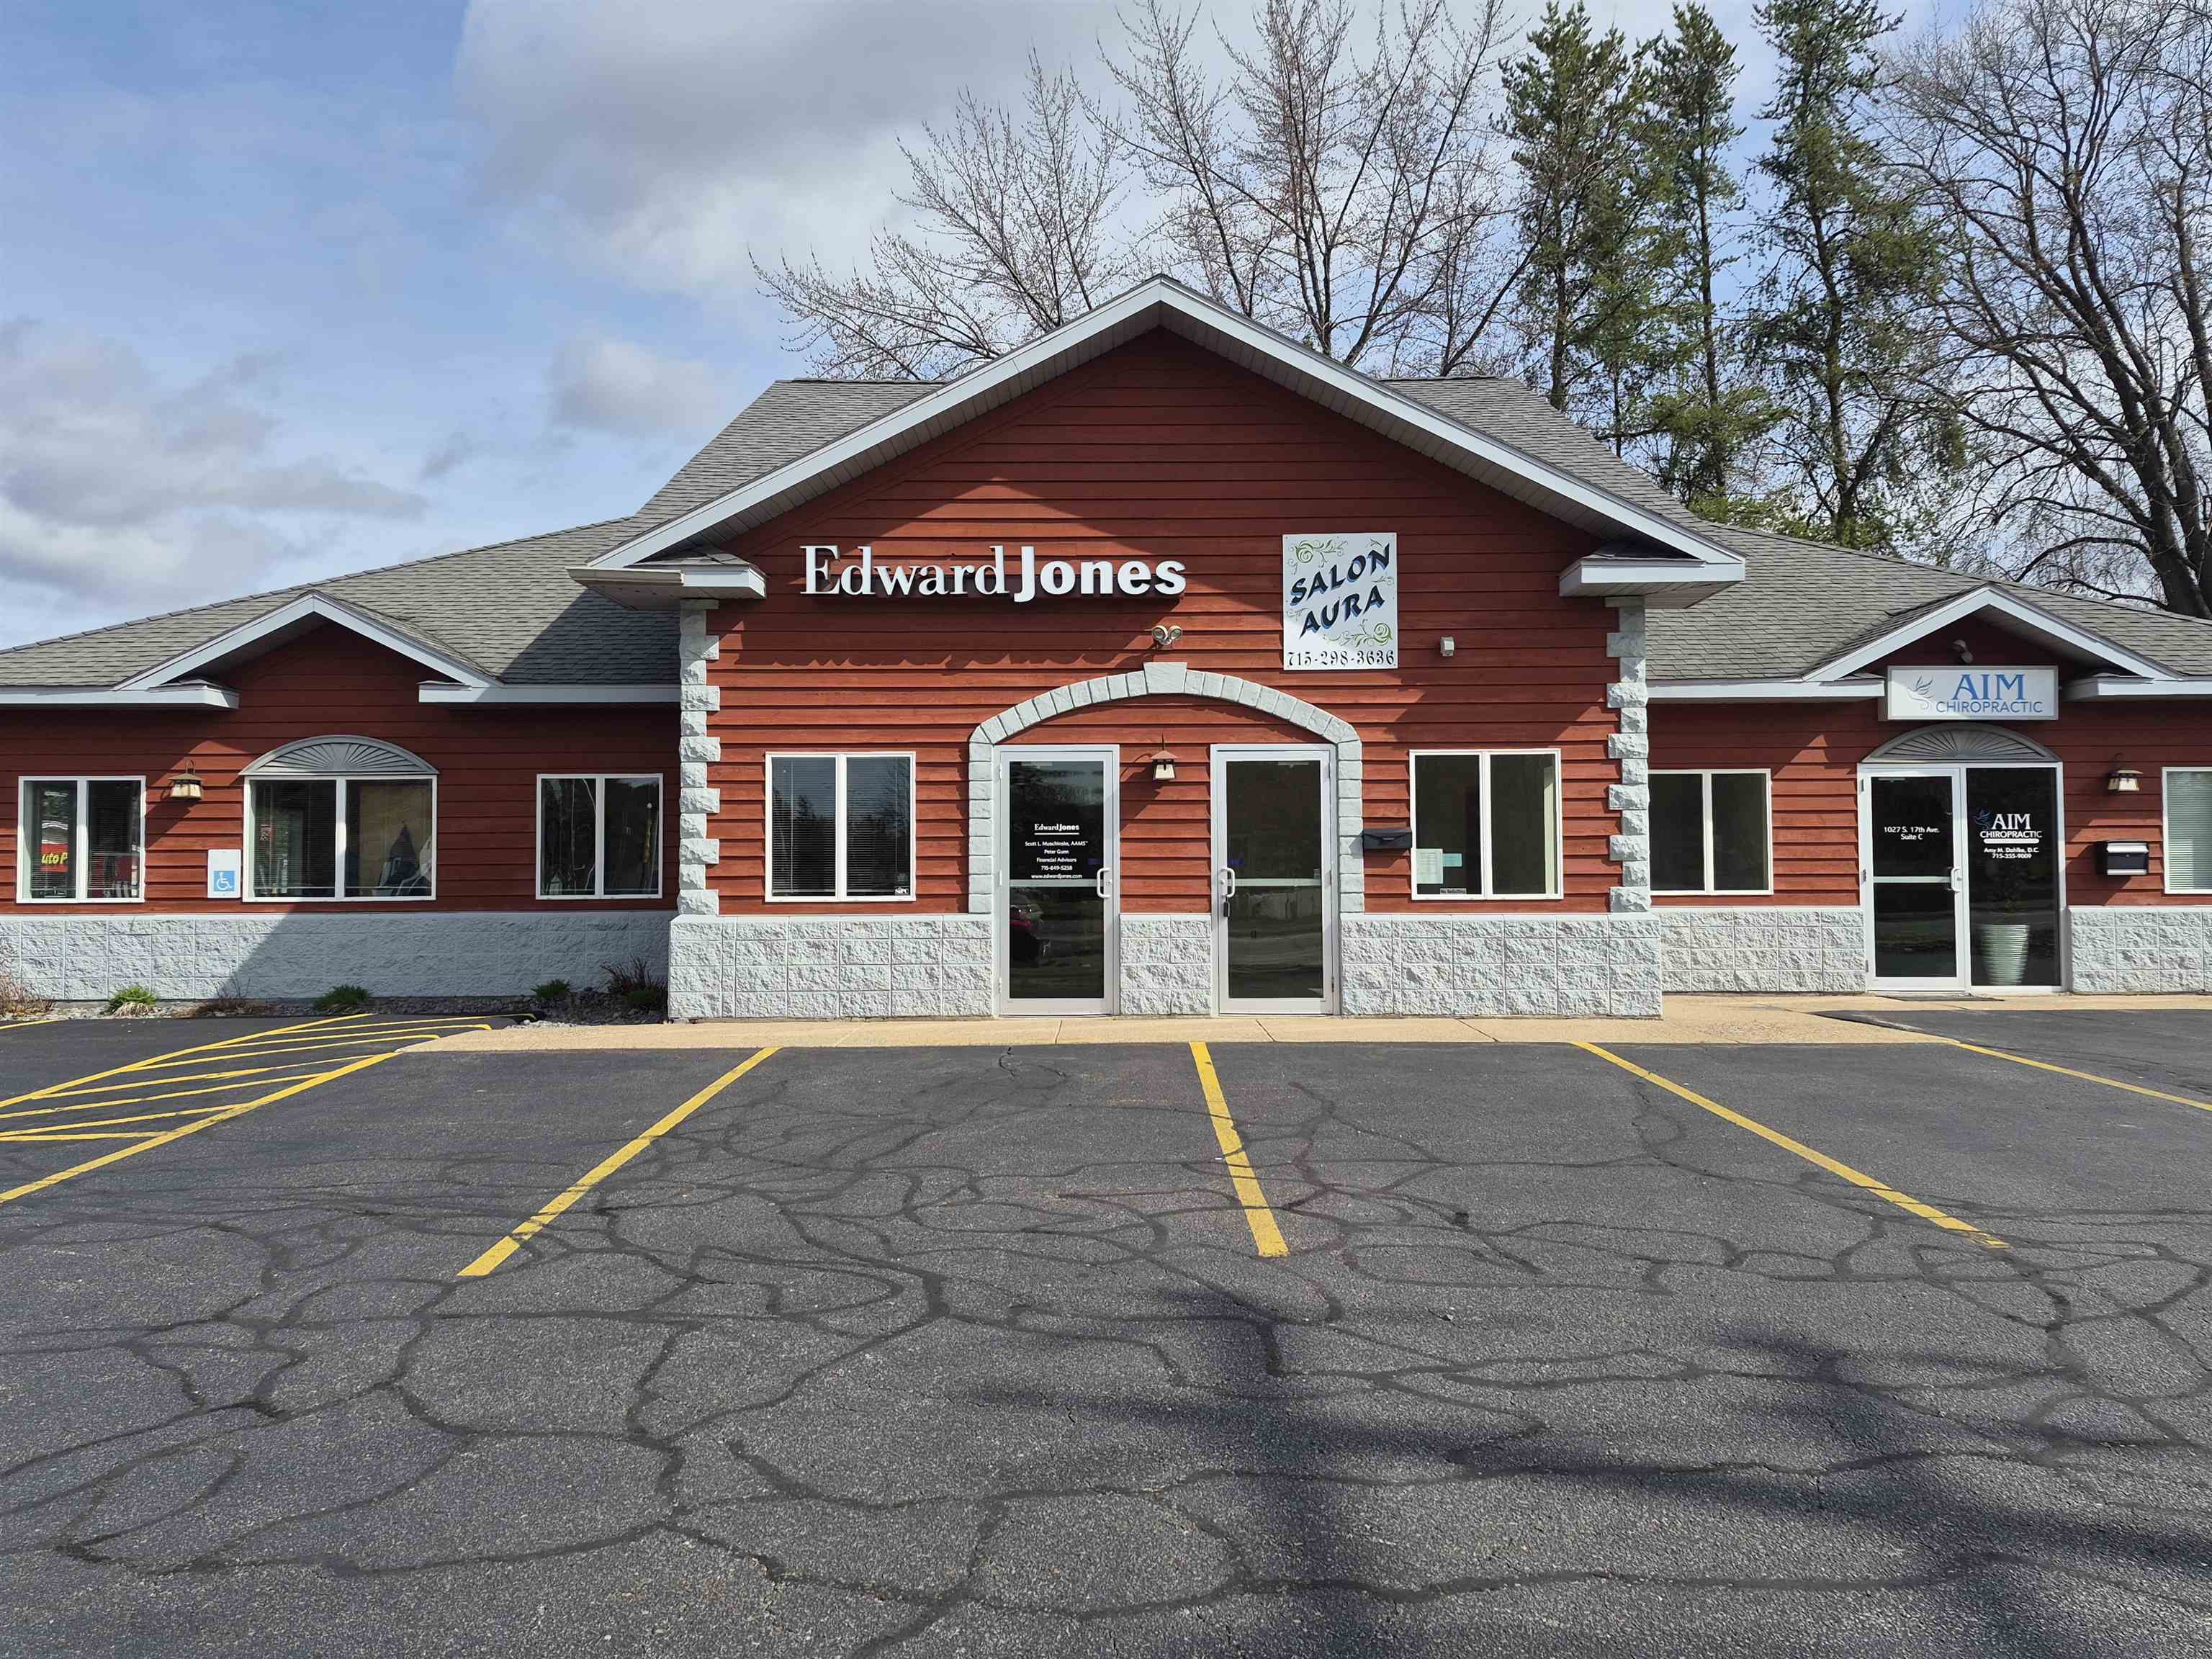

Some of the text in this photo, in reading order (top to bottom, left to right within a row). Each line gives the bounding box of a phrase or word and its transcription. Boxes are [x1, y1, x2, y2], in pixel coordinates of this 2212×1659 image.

[1290, 543, 1390, 606] SALON
[1299, 585, 1385, 639] AURA
[1287, 649, 1395, 667] 715-298-3636
[1952, 674, 2026, 700] AIM
[1936, 701, 2044, 714] CHIROPRACTIC
[1992, 814, 2031, 830] AIM
